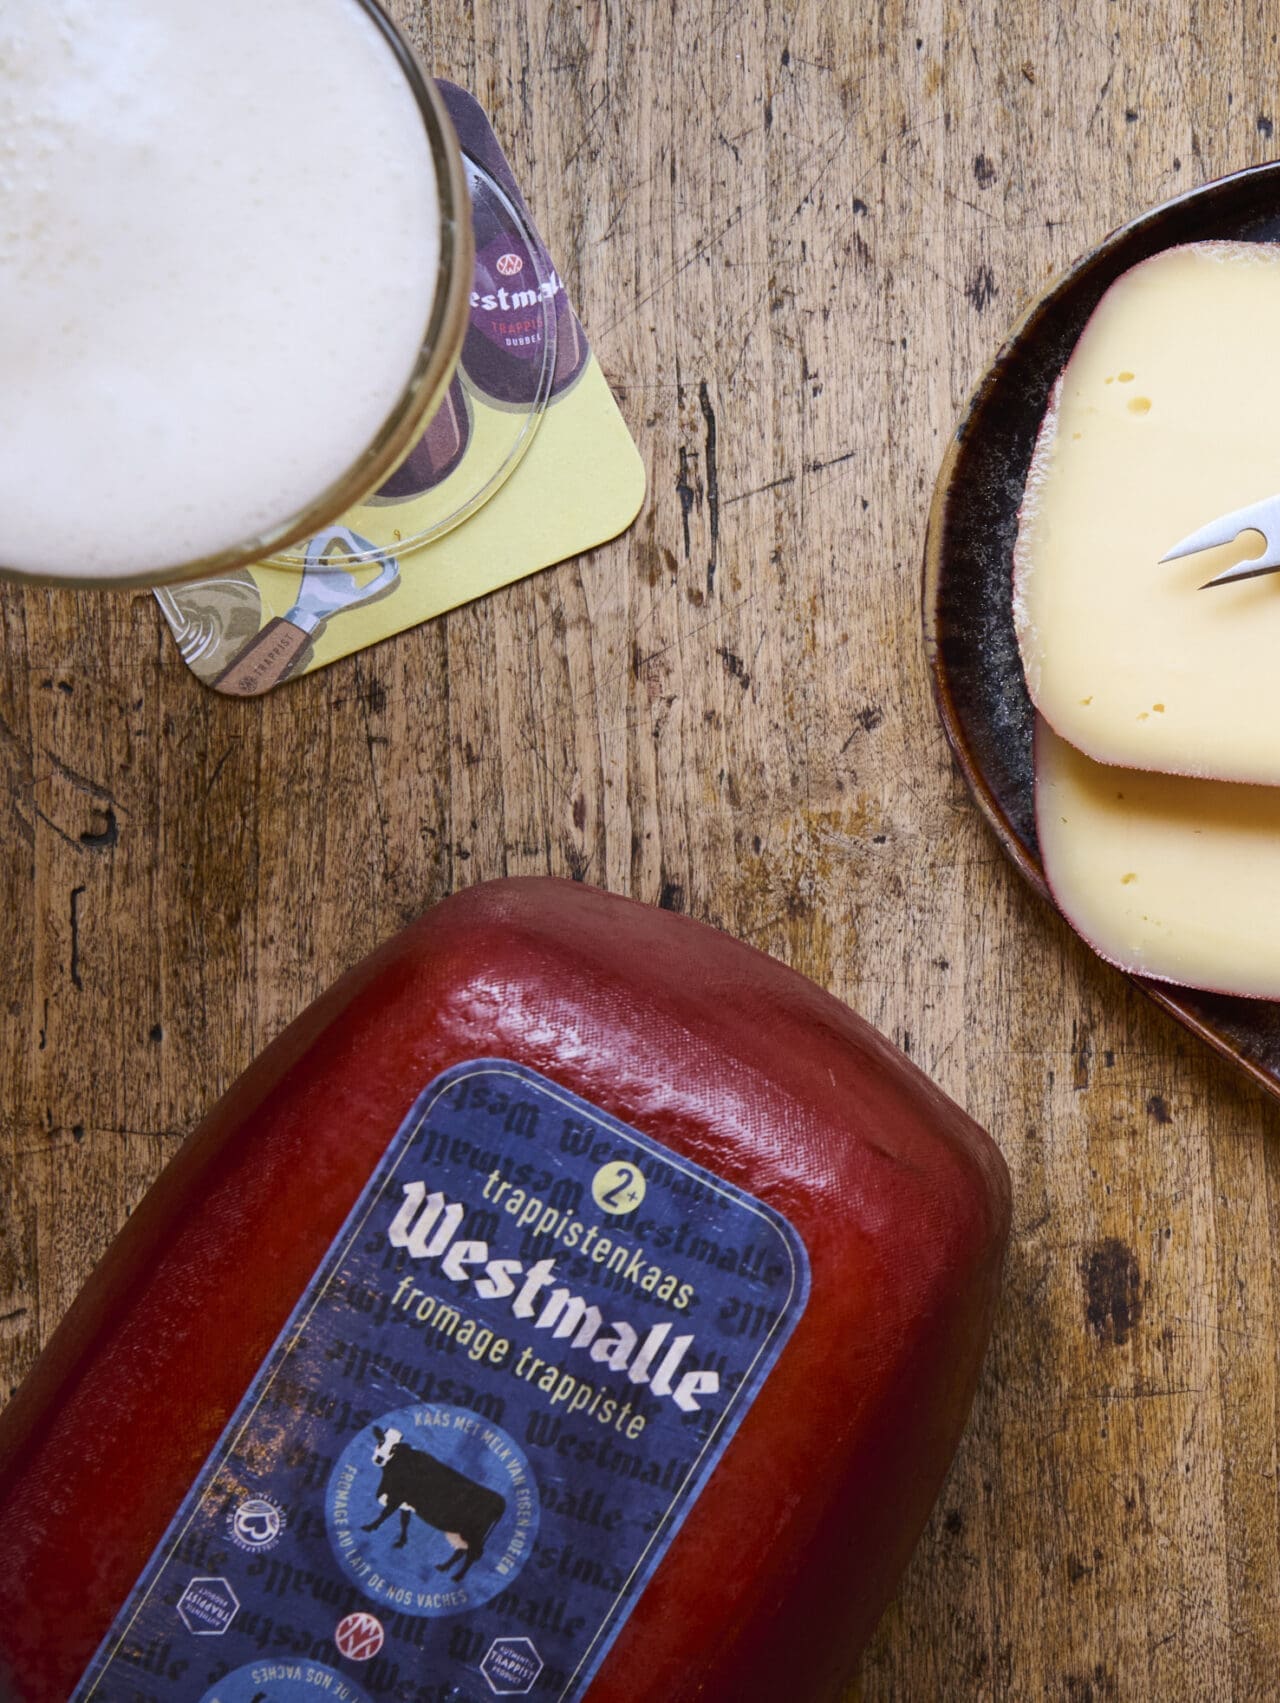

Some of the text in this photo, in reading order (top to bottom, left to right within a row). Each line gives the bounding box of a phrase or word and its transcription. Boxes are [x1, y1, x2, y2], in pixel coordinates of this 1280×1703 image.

[469, 270, 564, 311] estmal
[505, 333, 541, 346] DUBBEL
[253, 632, 293, 676] TRAPPIST
[602, 1168, 637, 1208] 2+
[483, 1170, 694, 1309] trappistenkaas
[389, 1181, 720, 1411] Westmalle
[392, 1276, 509, 1363] fromage
[515, 1352, 646, 1439] trappiste
[414, 1412, 531, 1575] KAAS MET MELK VAN EIGEN KOEIEN
[333, 1465, 467, 1609] FROMAGE AU LAIT DE NOS VACHES
[185, 1590, 230, 1621] TRAPPIST
[251, 1665, 349, 1700] DE NOS VACHES
[488, 1650, 534, 1681] TRAPPIST
